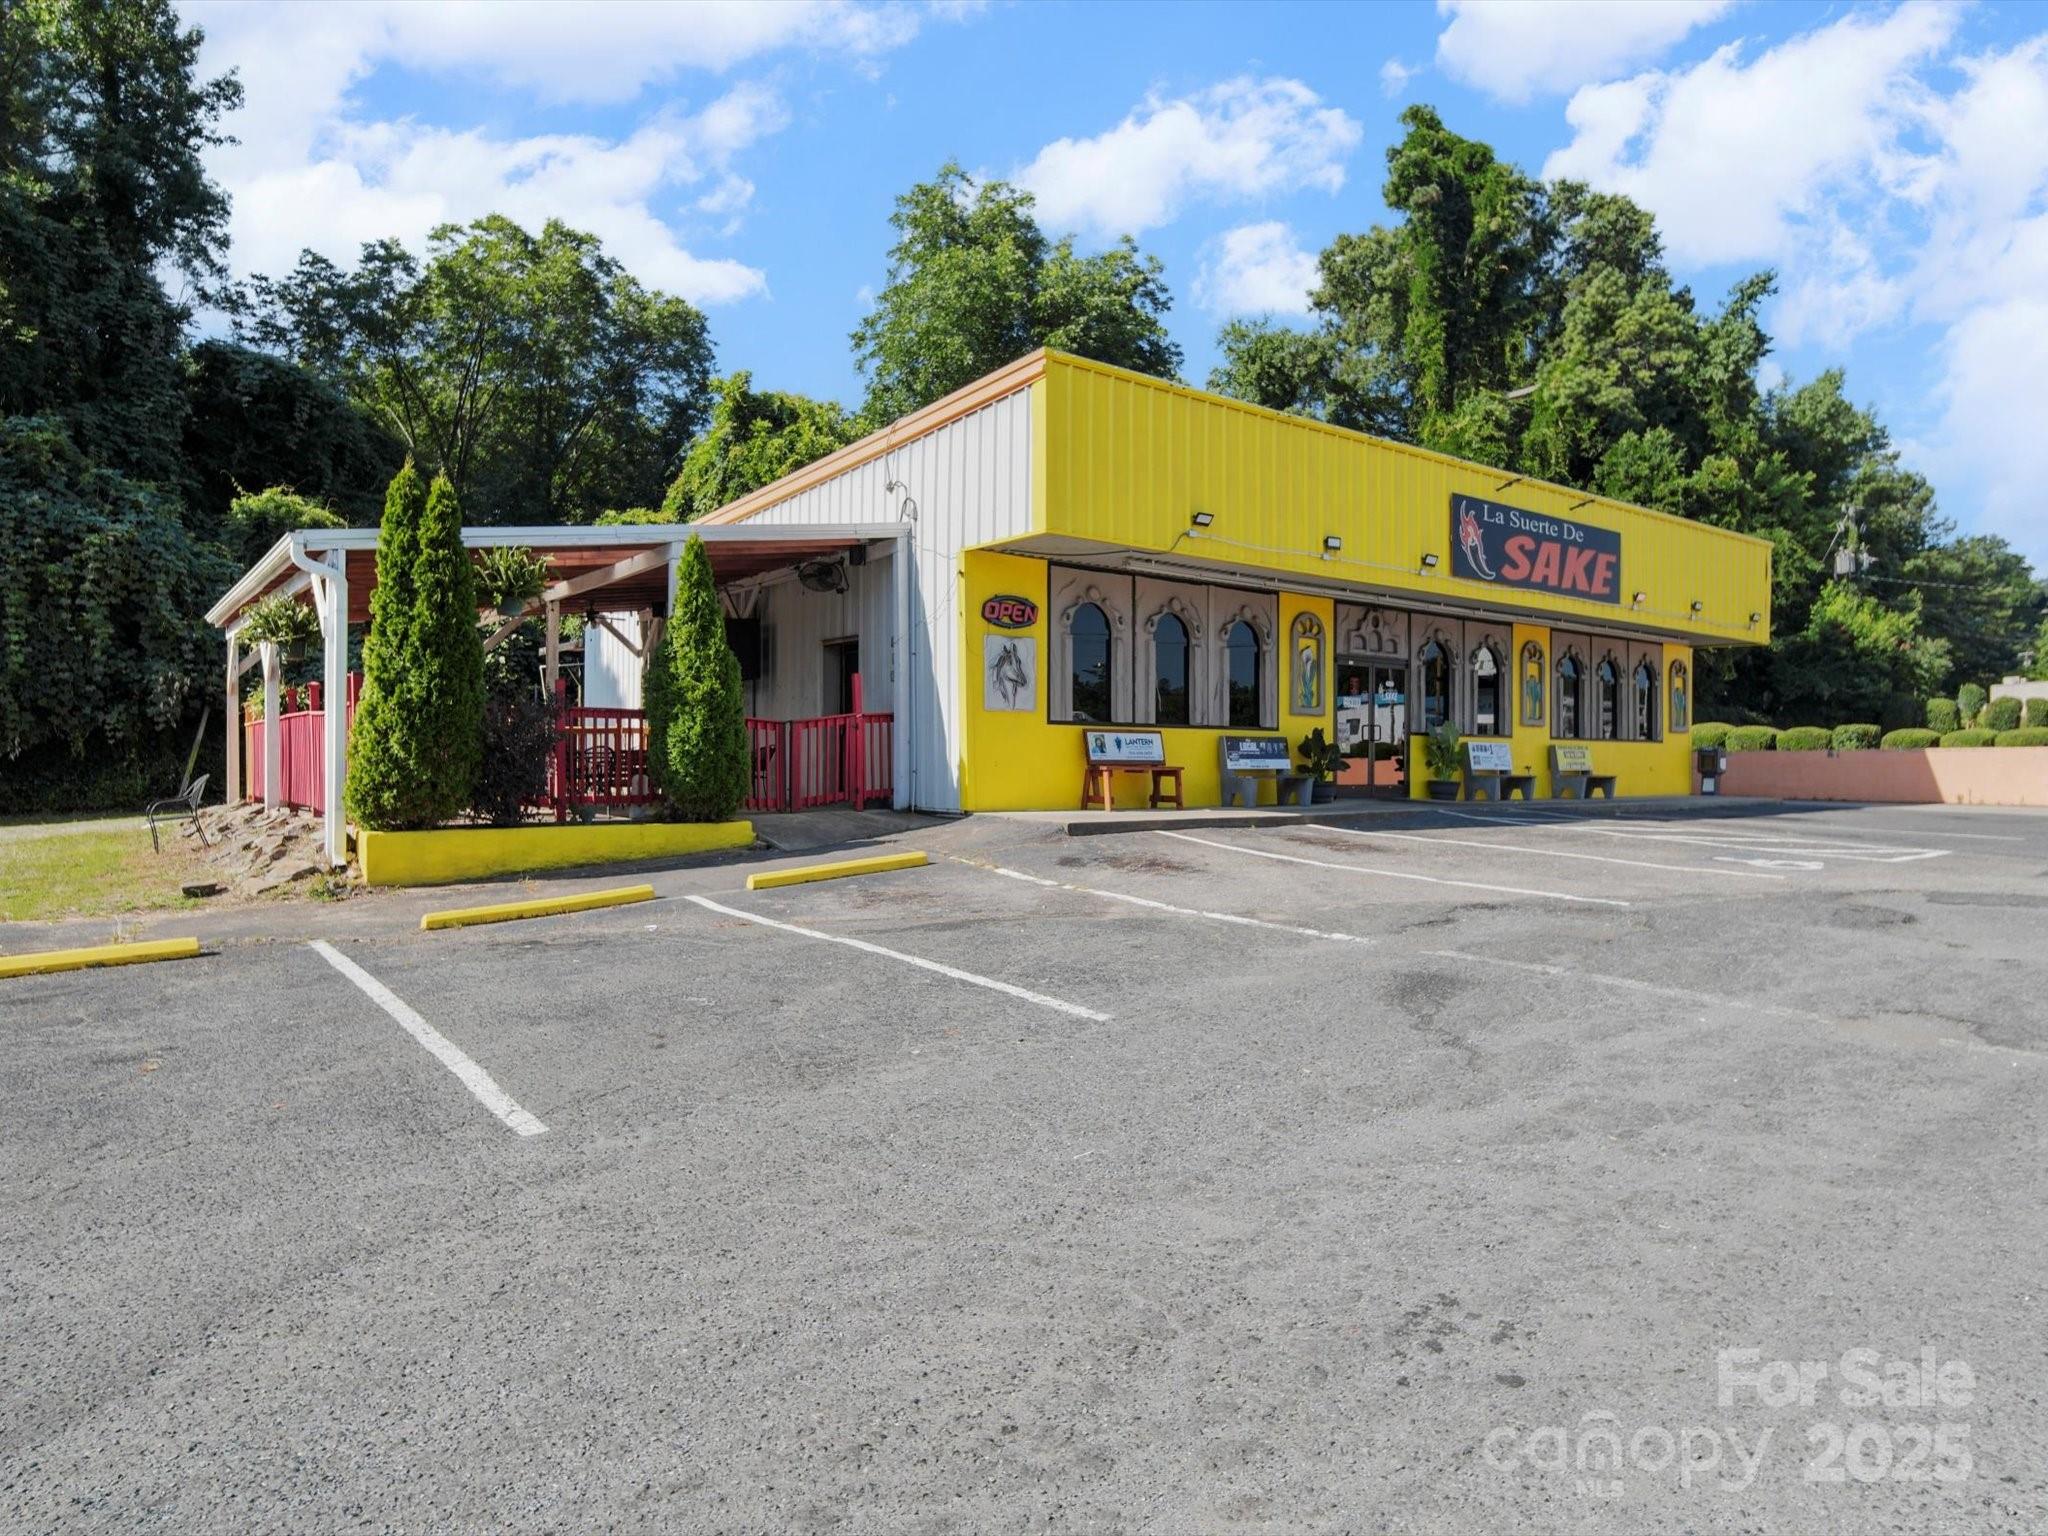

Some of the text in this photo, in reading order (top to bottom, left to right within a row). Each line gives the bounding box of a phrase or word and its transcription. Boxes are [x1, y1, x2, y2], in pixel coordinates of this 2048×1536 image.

[1483, 503, 1584, 542] La Suerte De
[1501, 534, 1617, 595] SAKE
[984, 601, 1039, 623] OPEN
[1125, 738, 1153, 746] LANTERN
